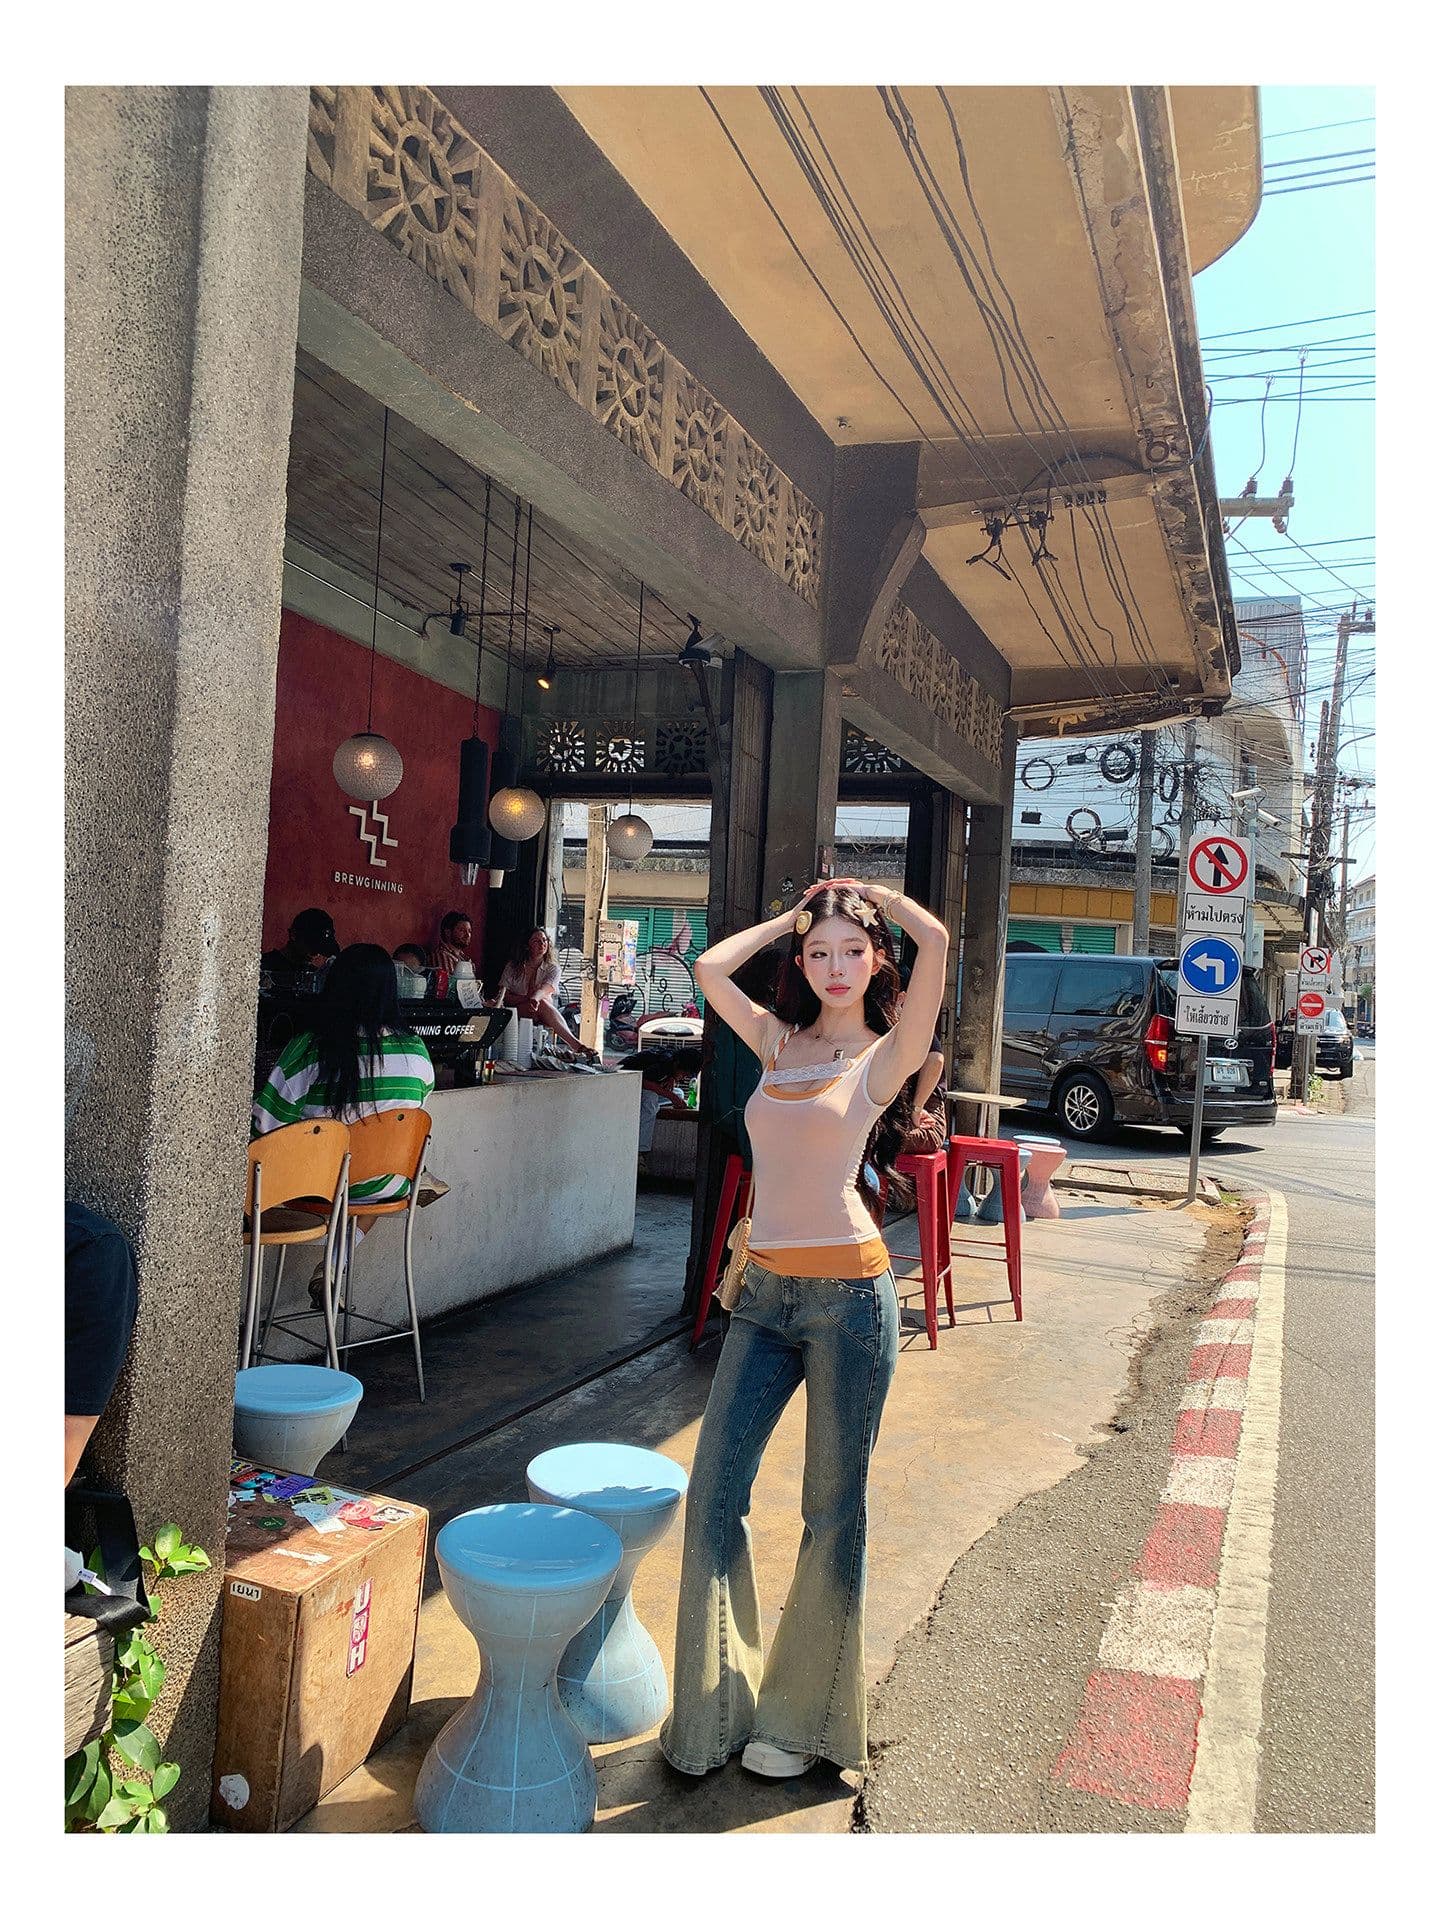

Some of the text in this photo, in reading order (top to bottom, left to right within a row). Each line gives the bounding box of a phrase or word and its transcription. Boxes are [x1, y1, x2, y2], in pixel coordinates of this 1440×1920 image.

[334, 871, 403, 893] BREWGINNING
[1185, 904, 1244, 923] ห้ามไปตรง
[444, 1025, 475, 1035] COFFEE
